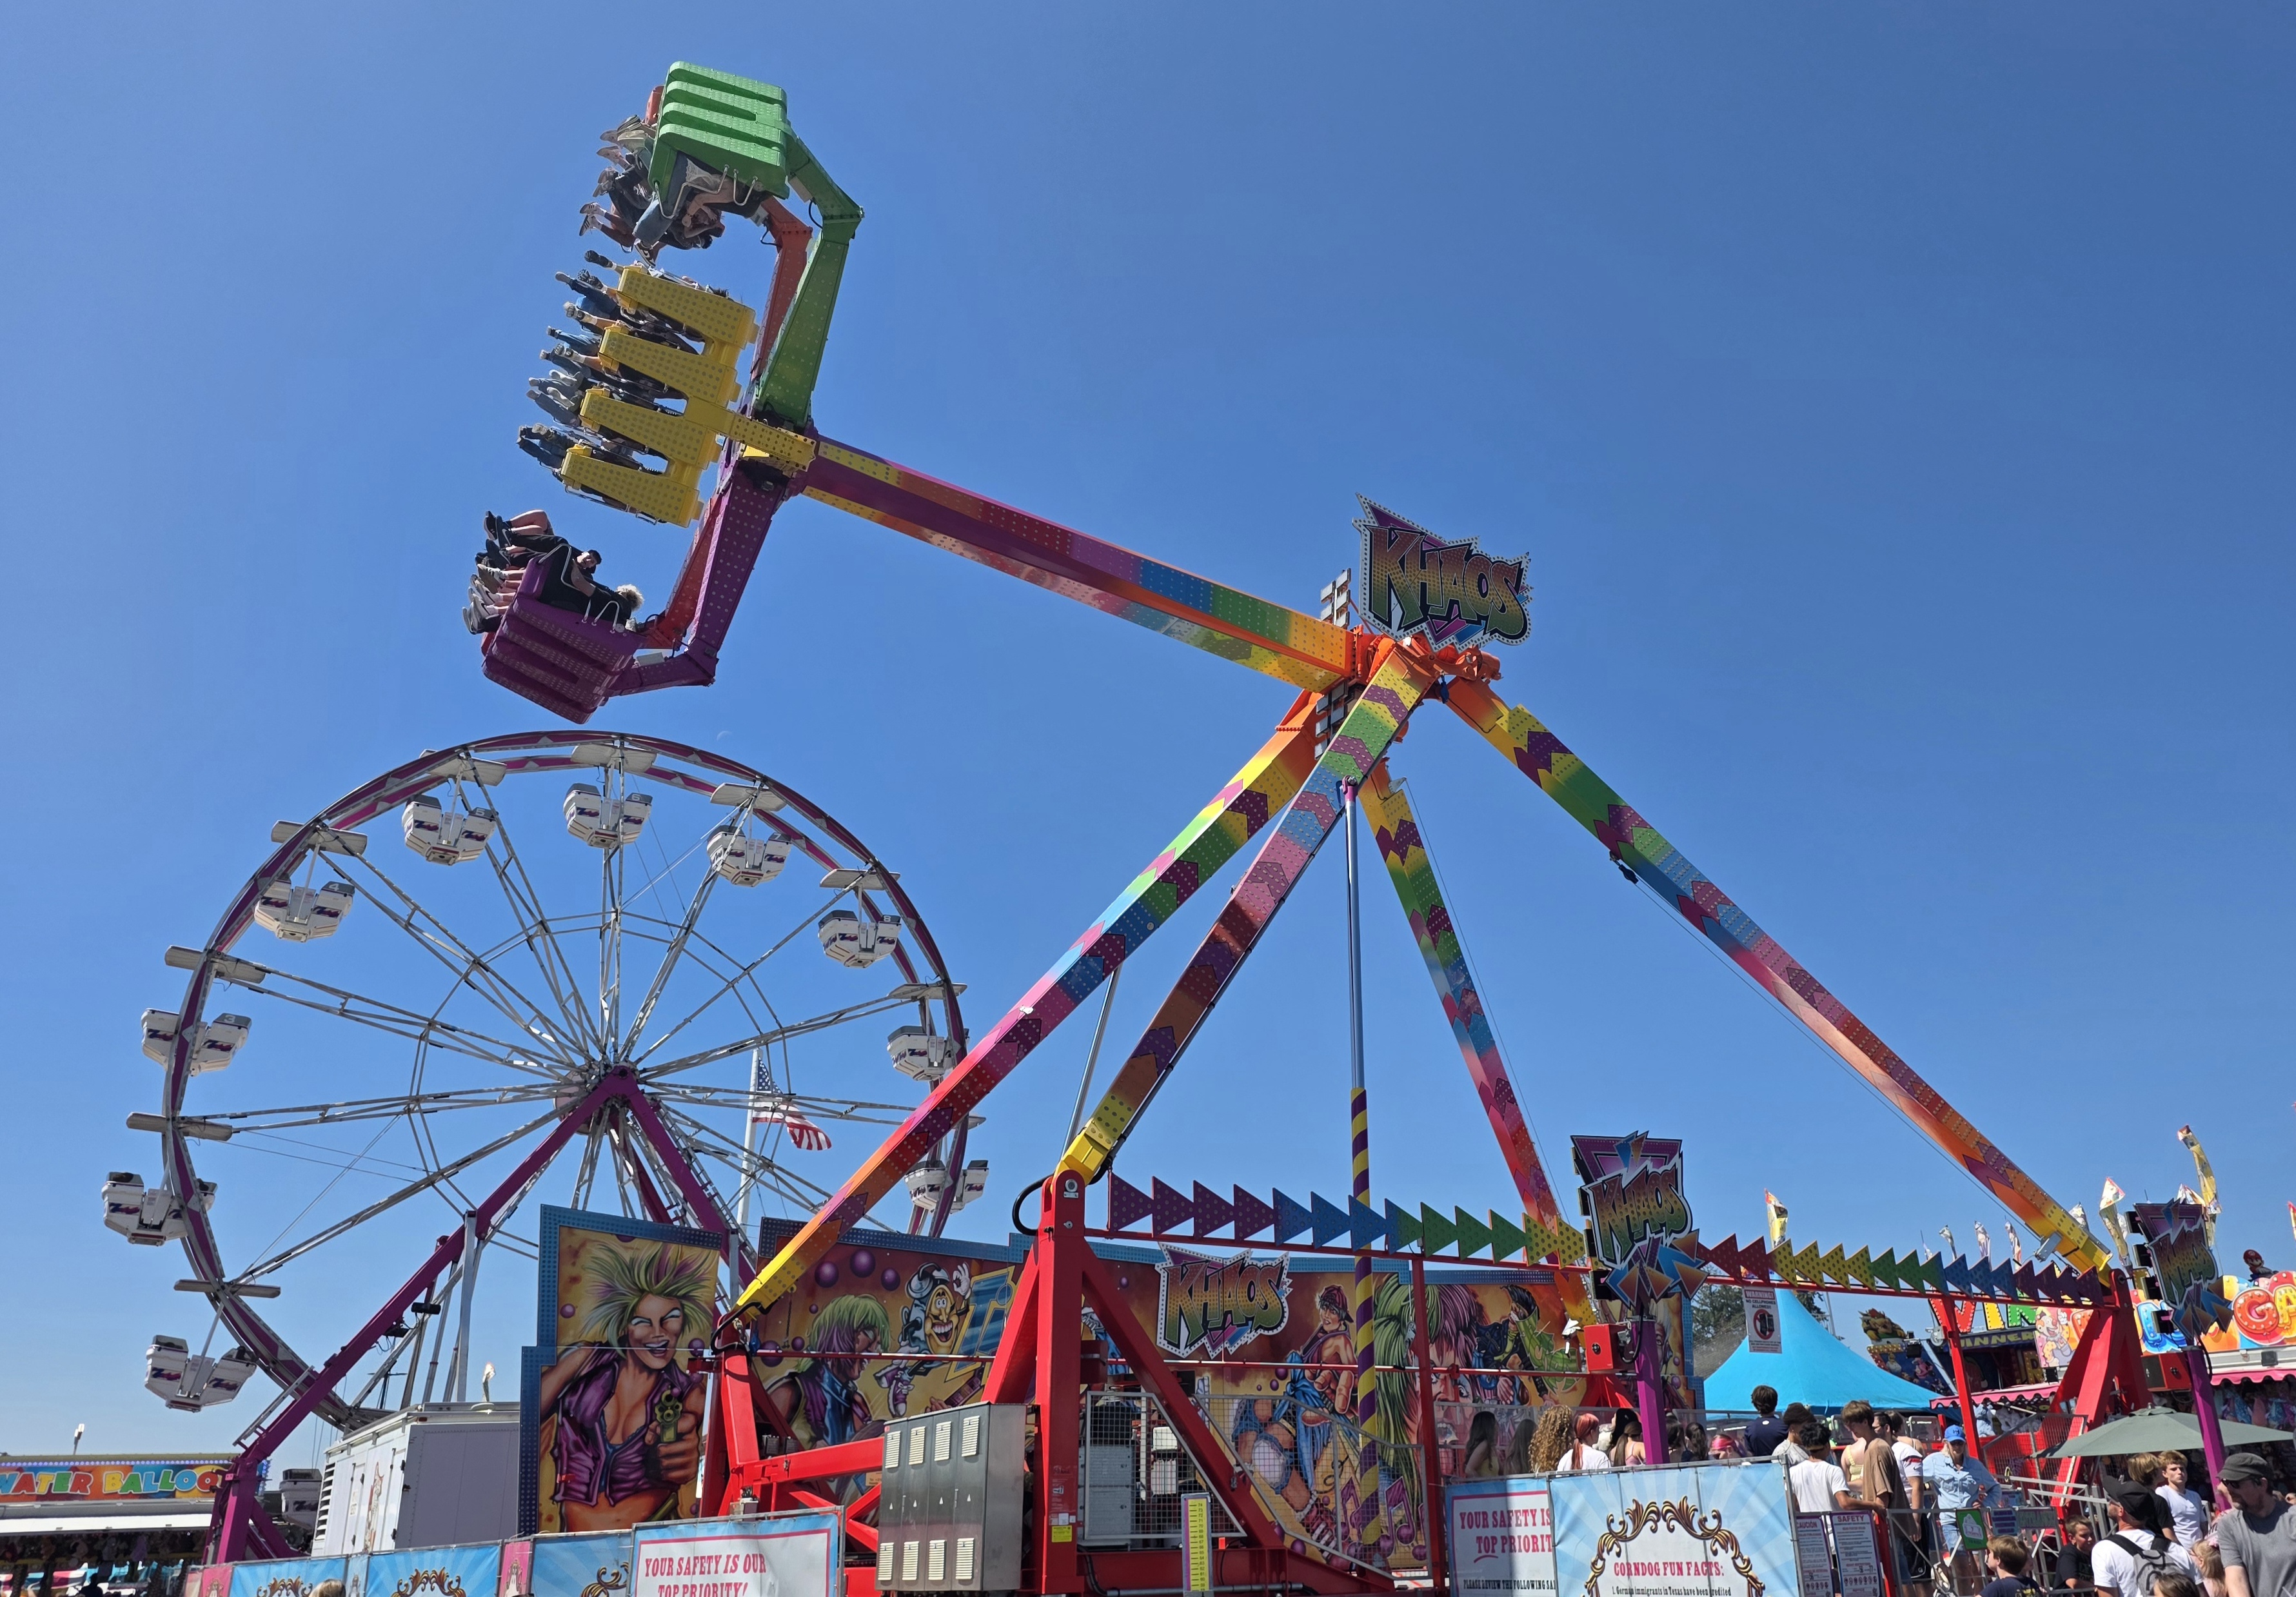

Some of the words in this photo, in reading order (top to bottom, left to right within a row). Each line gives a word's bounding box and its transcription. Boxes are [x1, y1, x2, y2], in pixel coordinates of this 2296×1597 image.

[1363, 524, 1527, 639] KHAOS
[475, 808, 485, 816] 5
[224, 1015, 236, 1023] 3
[1588, 1166, 1688, 1260] KHAOS
[1745, 1290, 1774, 1299] WARNING!
[1163, 1258, 1285, 1349] KHAOS
[1960, 1331, 2035, 1348] INNER
[0, 1471, 94, 1494] WATER
[103, 1469, 219, 1494] BALLOO
[1460, 1511, 1489, 1529] YOUR
[1492, 1509, 1538, 1528] SAFETY
[1476, 1536, 1498, 1554] TOP
[1500, 1534, 1552, 1554] PRIORIT
[645, 1557, 674, 1577] YOUR
[677, 1554, 722, 1576] SAFETY
[723, 1554, 740, 1574] IS
[743, 1553, 767, 1574] OUR
[1614, 1562, 1660, 1576] CORNDOG
[1662, 1562, 1684, 1576] FUN
[1686, 1561, 1725, 1576] FACTS:
[658, 1584, 680, 1597] TOP
[1463, 1579, 1481, 1589] PLEASE
[1482, 1579, 1501, 1589] REVIEW
[1502, 1579, 1512, 1589] THE
[1514, 1579, 1545, 1589] FOLLOWING
[1616, 1586, 1634, 1595] German
[1634, 1586, 1663, 1597] immigrants
[1663, 1587, 1668, 1595] in
[1668, 1586, 1683, 1596] Texas
[1683, 1586, 1696, 1596] have
[1696, 1587, 1708, 1596] been
